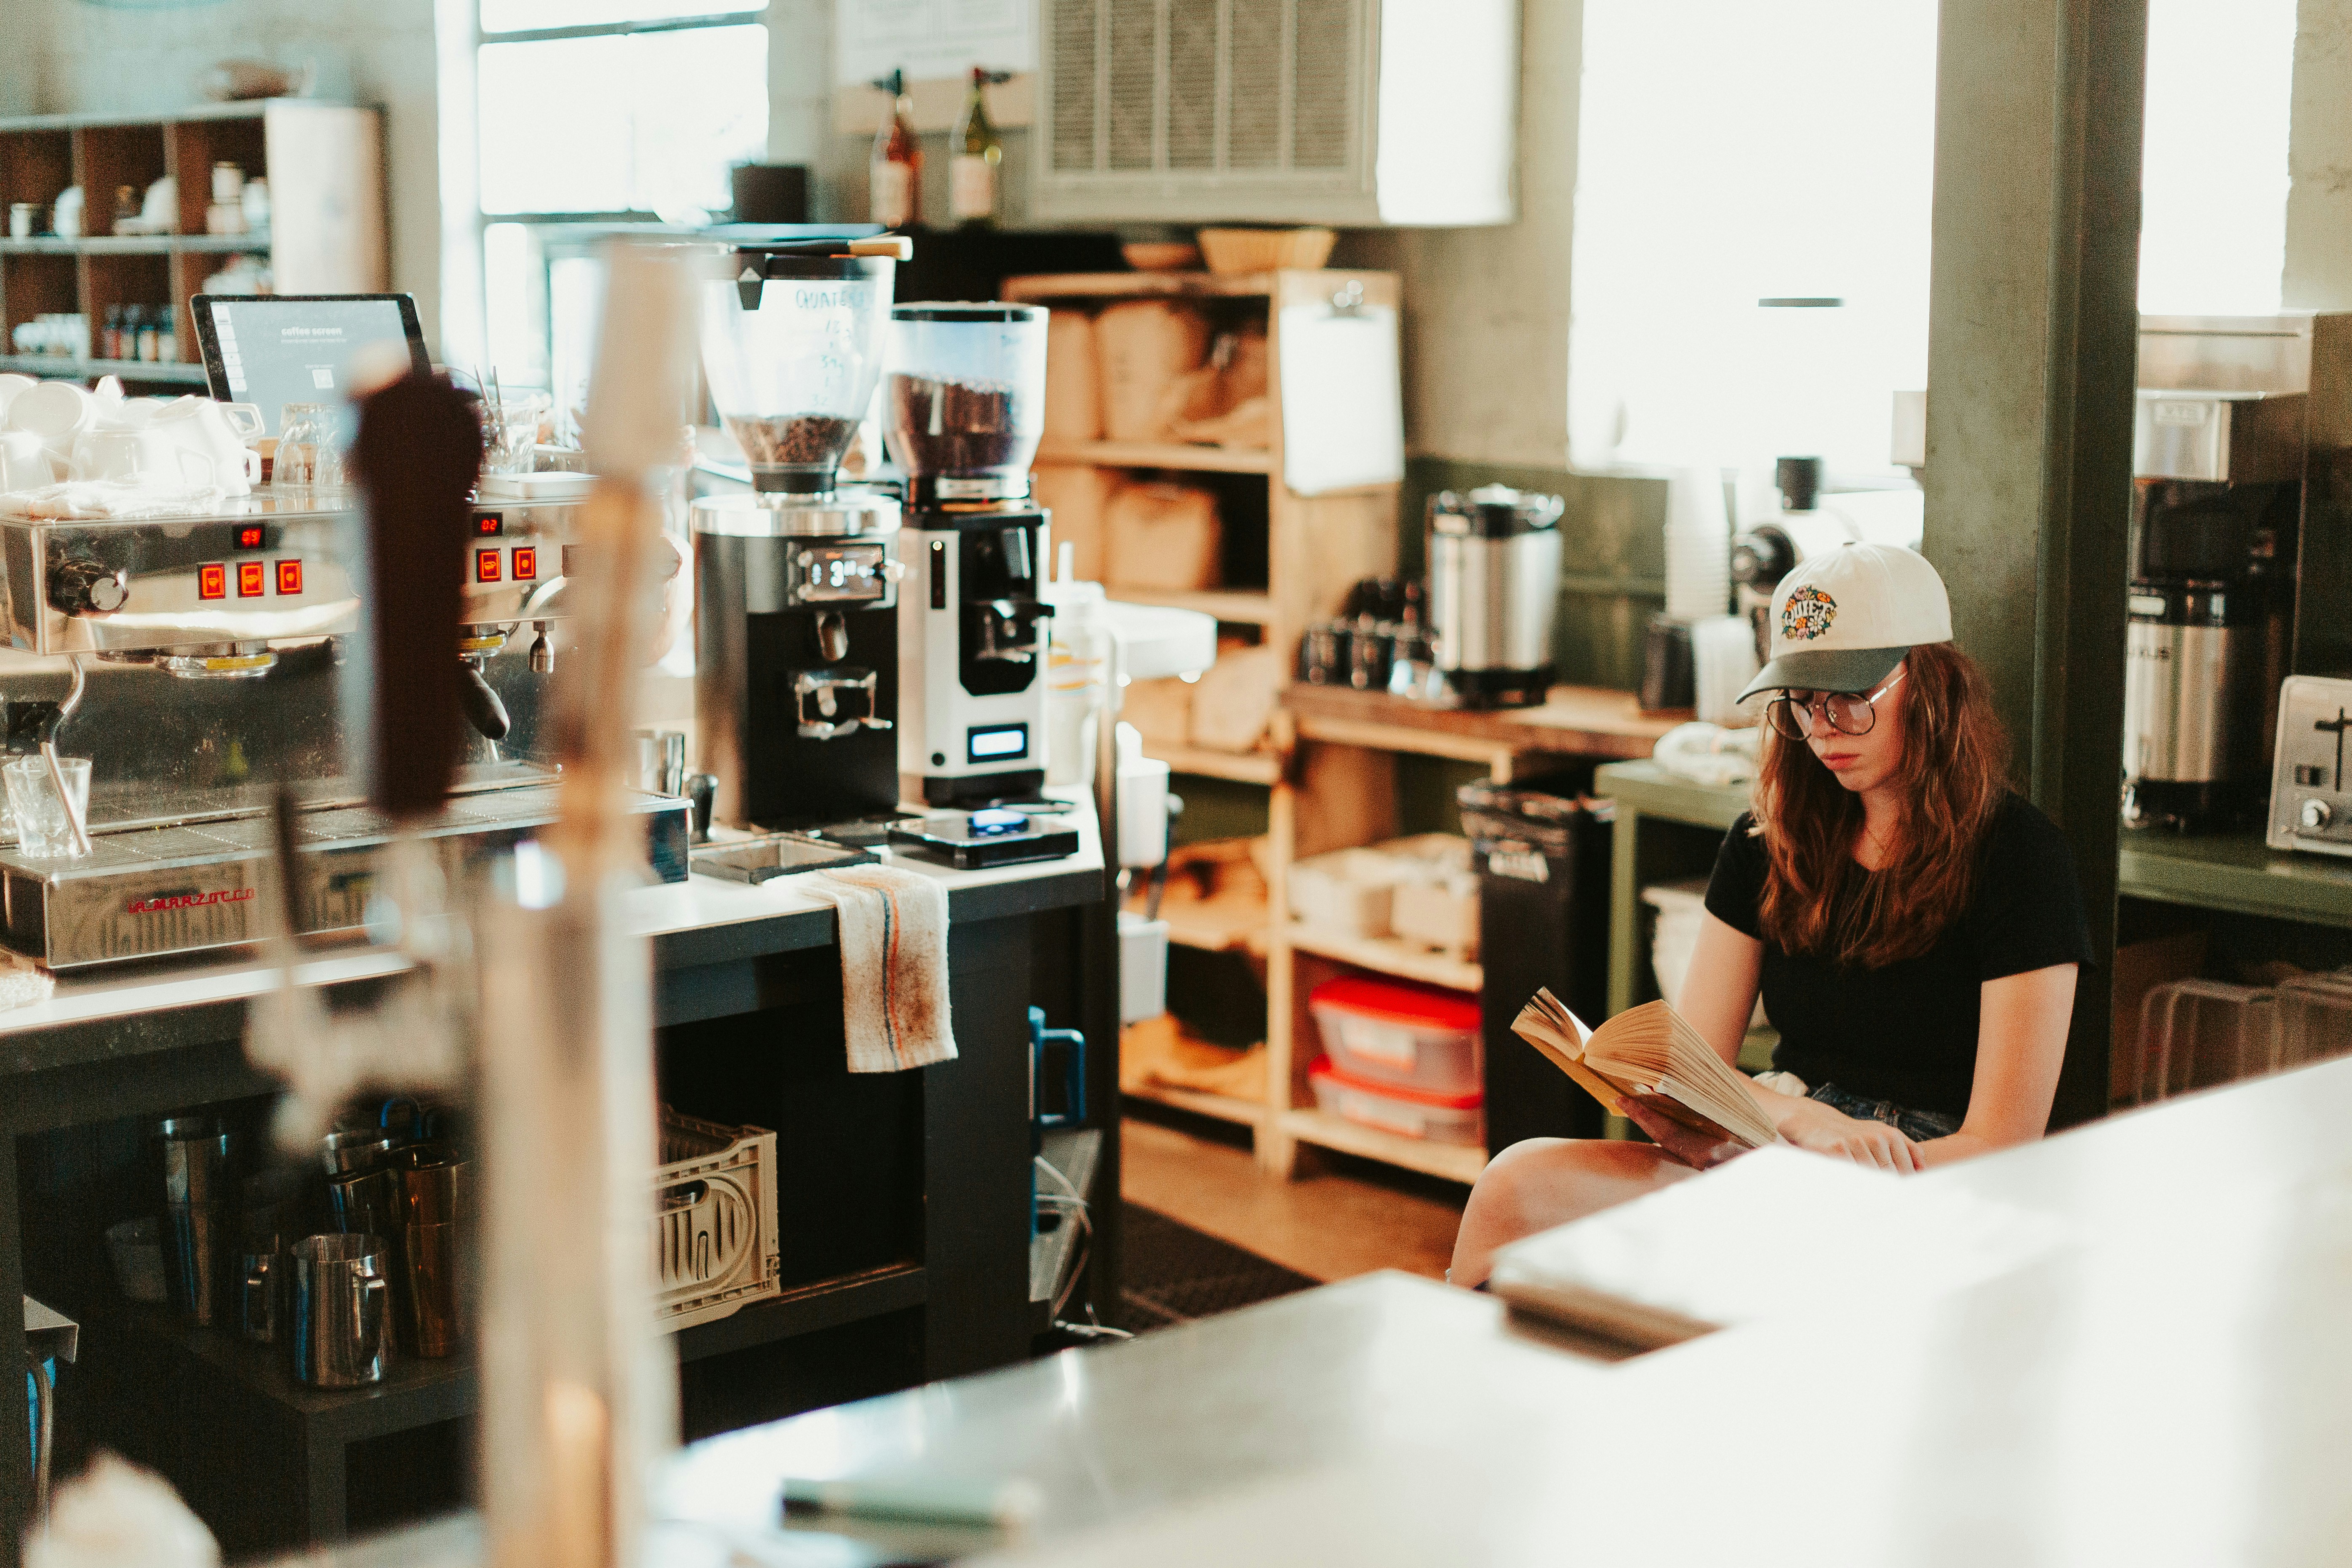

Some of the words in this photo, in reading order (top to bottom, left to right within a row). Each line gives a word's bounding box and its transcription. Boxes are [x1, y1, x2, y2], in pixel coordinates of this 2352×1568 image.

[281, 326, 310, 336] coffee
[311, 327, 342, 336] screen
[483, 520, 496, 530] 02
[1785, 599, 1835, 627] QUIET
